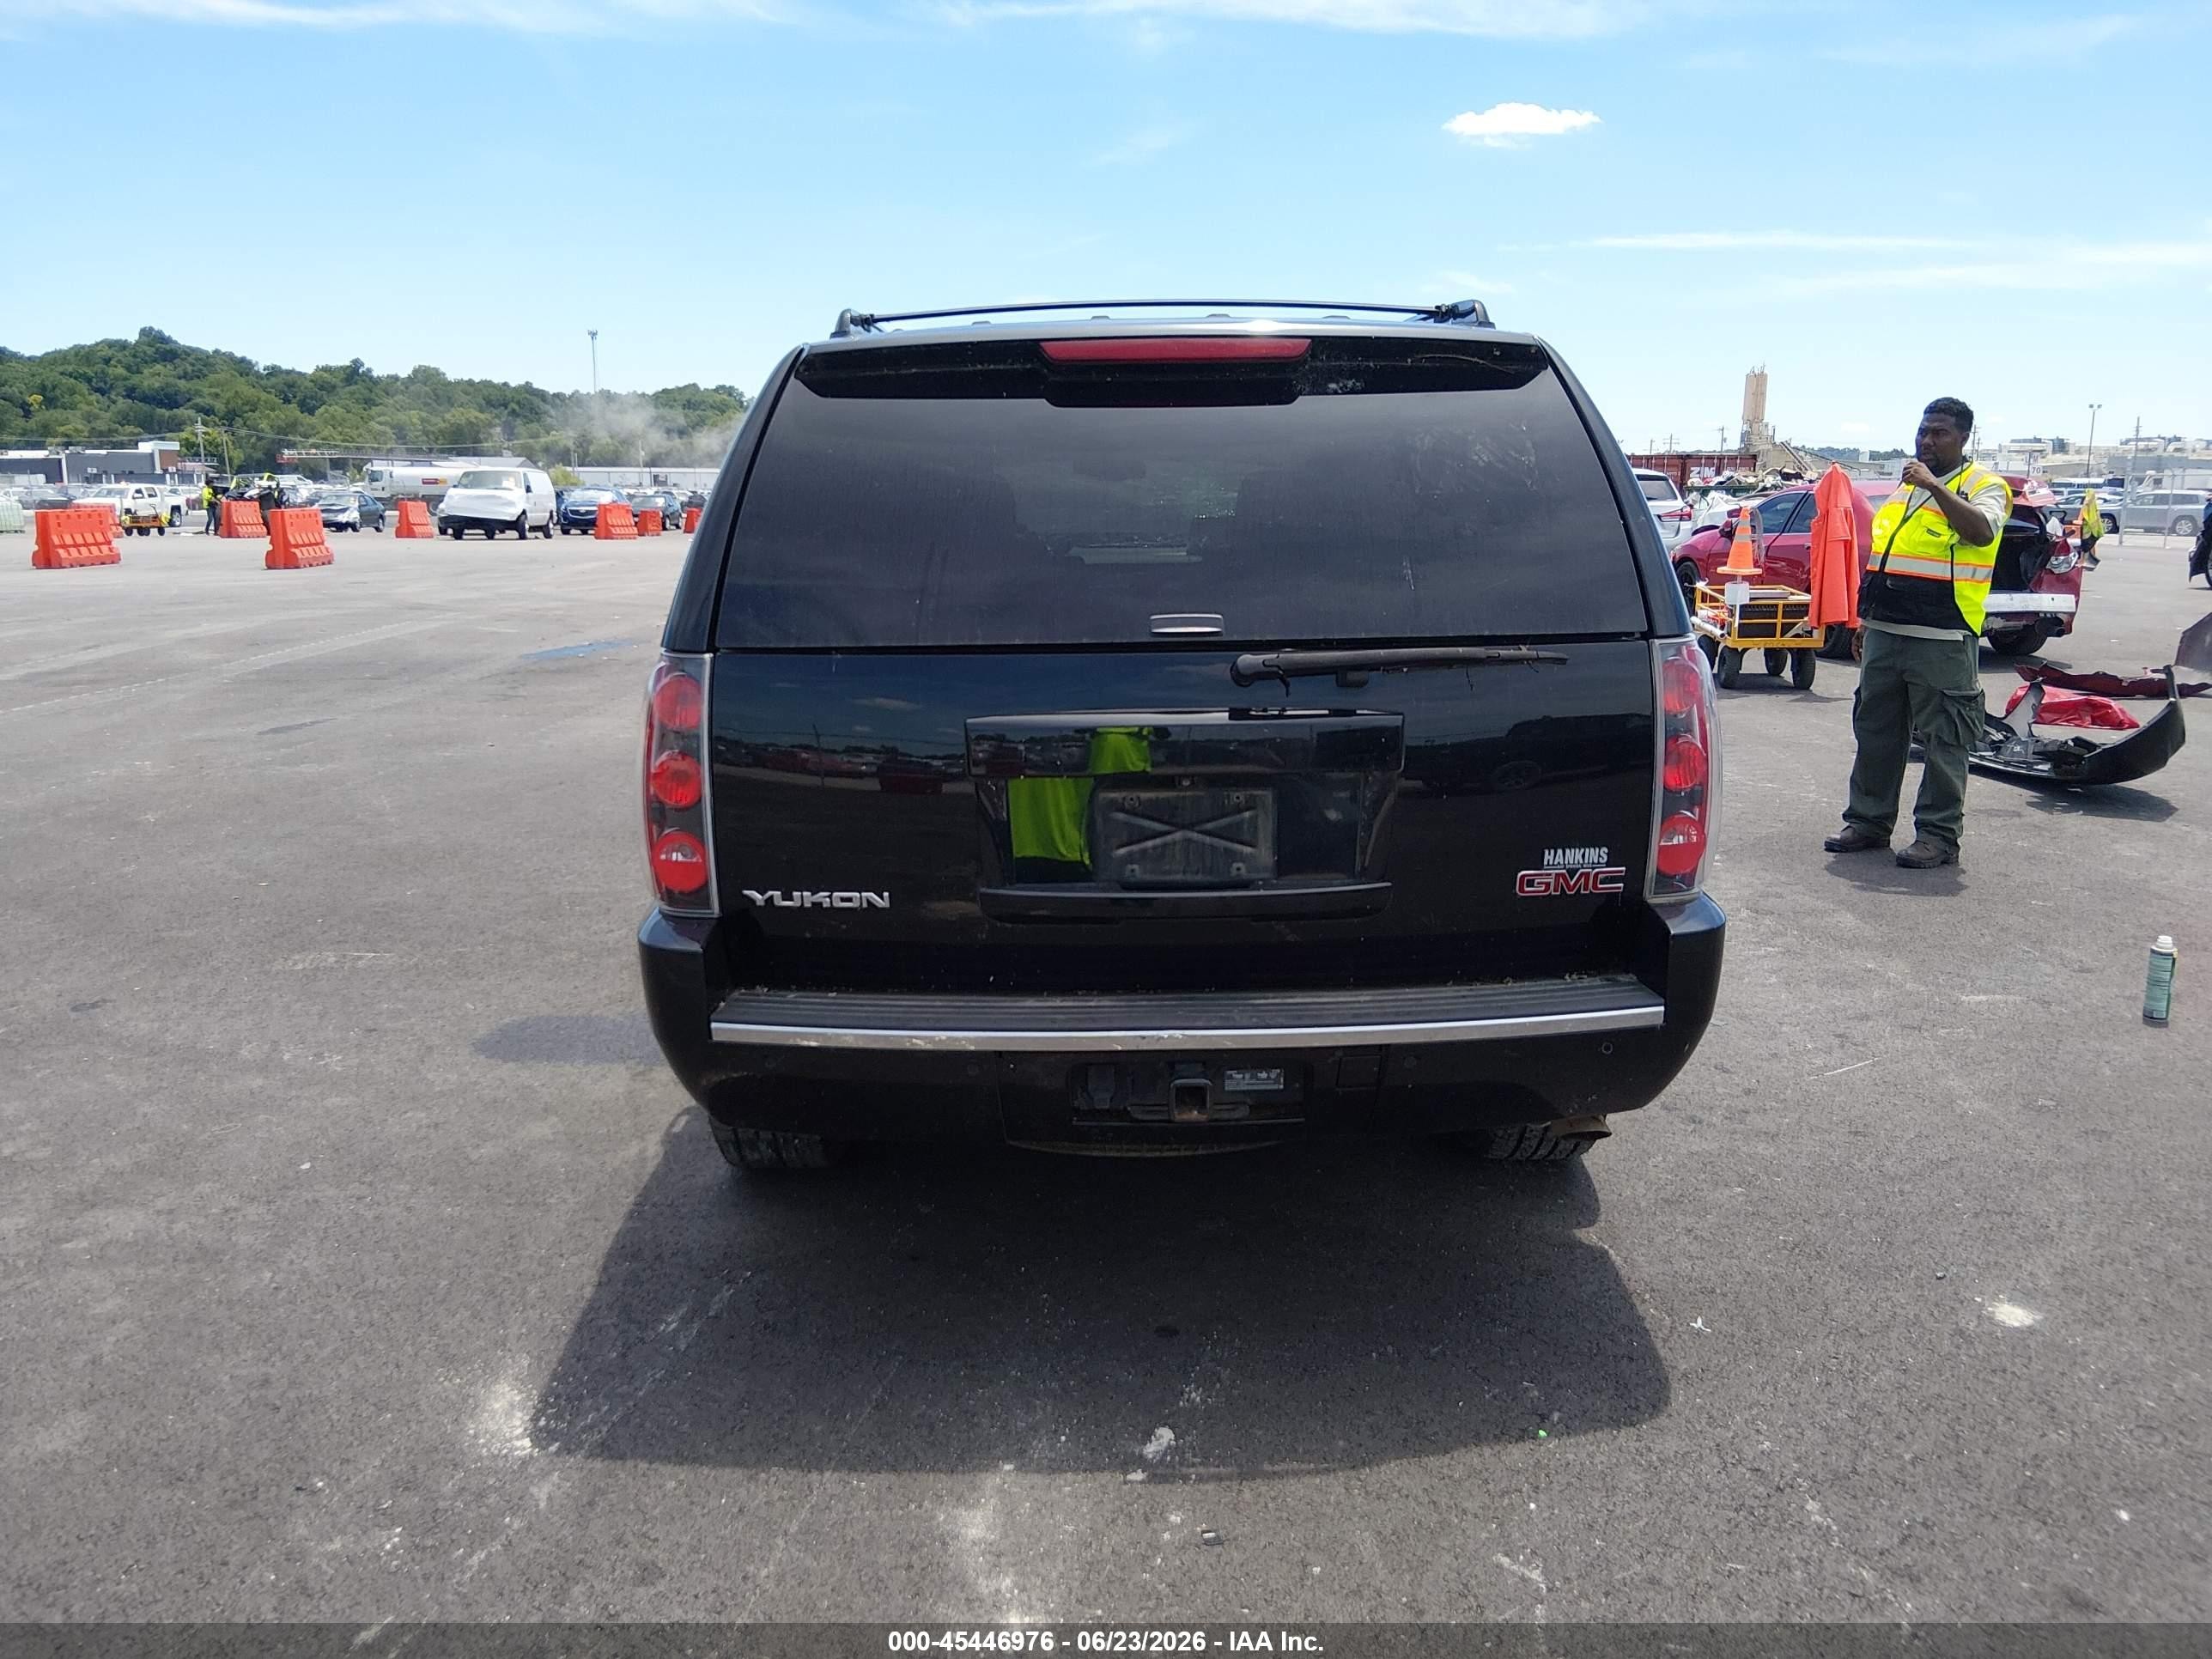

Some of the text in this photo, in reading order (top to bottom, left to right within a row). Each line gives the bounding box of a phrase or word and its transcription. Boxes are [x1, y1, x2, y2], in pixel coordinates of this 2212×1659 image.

[1689, 466, 1716, 478] ZIM
[1544, 847, 1608, 866] HANKINS
[1516, 866, 1626, 896] GMC
[742, 890, 890, 908] YUKON
